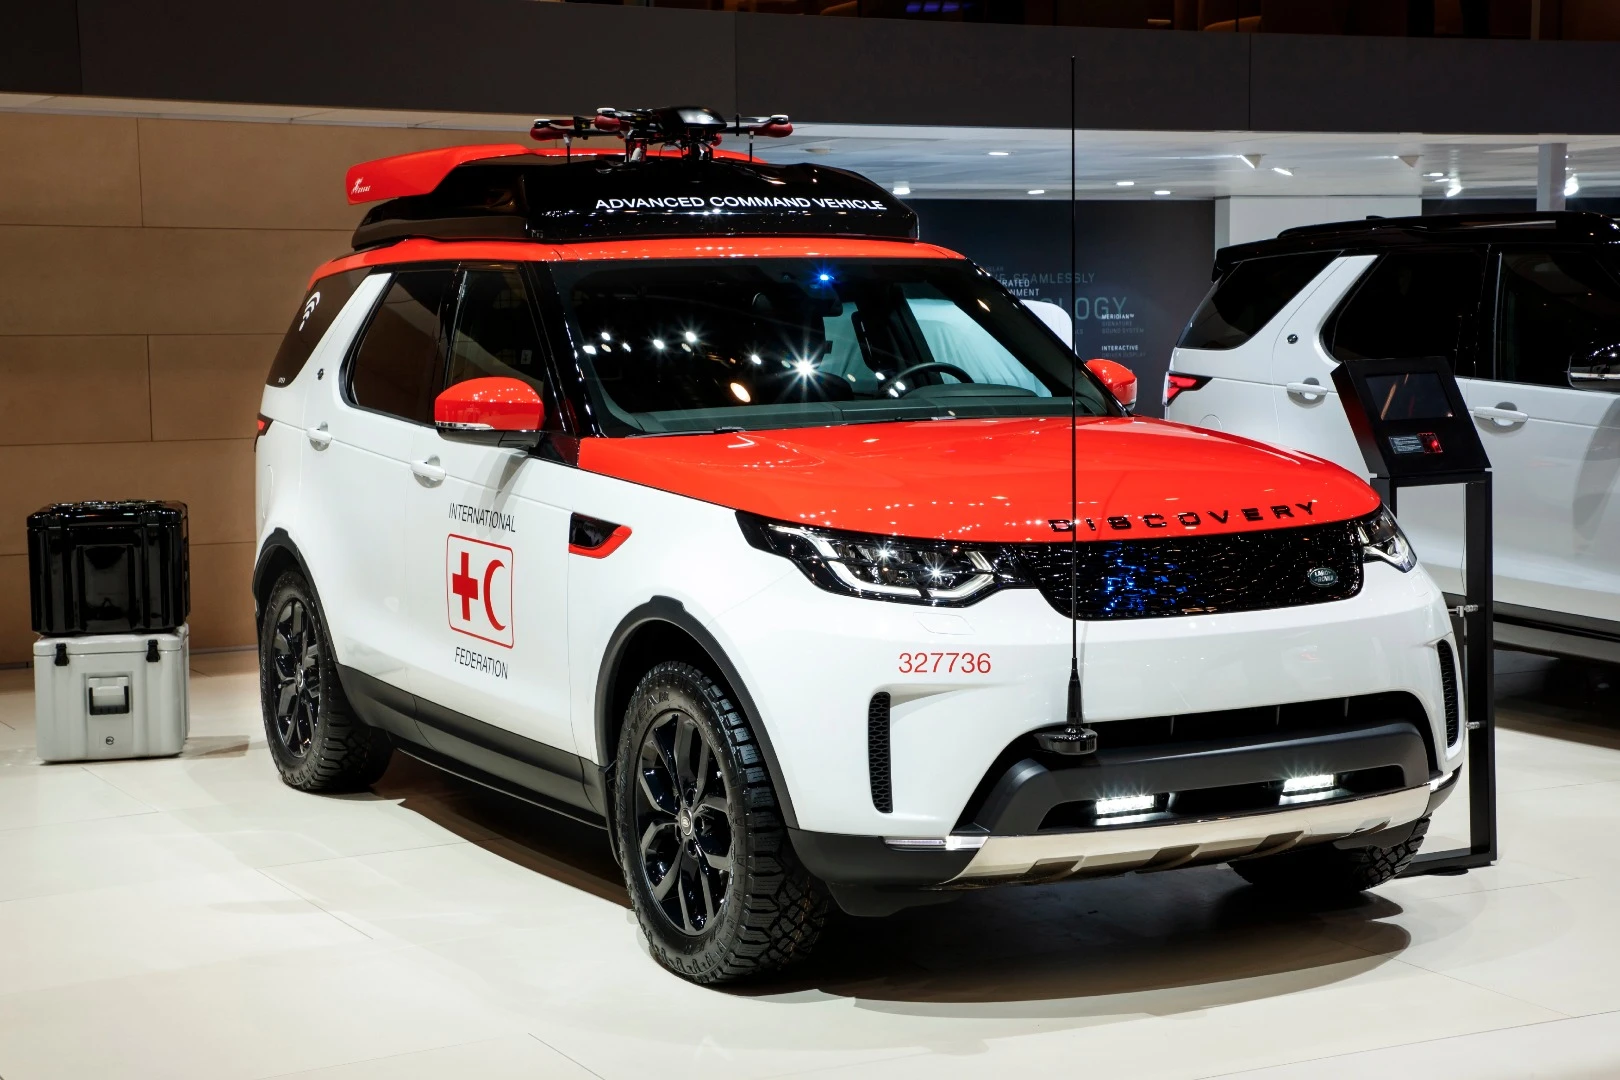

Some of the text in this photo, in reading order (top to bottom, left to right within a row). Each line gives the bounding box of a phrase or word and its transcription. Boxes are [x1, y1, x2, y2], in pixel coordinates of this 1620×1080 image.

[595, 196, 888, 210] ADVANCED COMMAND VEHICLE
[1013, 272, 1096, 285] SEAMLESSLY
[448, 502, 516, 533] INTERNATIONAL
[1048, 501, 1314, 533] DISCOVERY
[454, 646, 509, 680] FEDERATION
[898, 652, 992, 674] 327736
